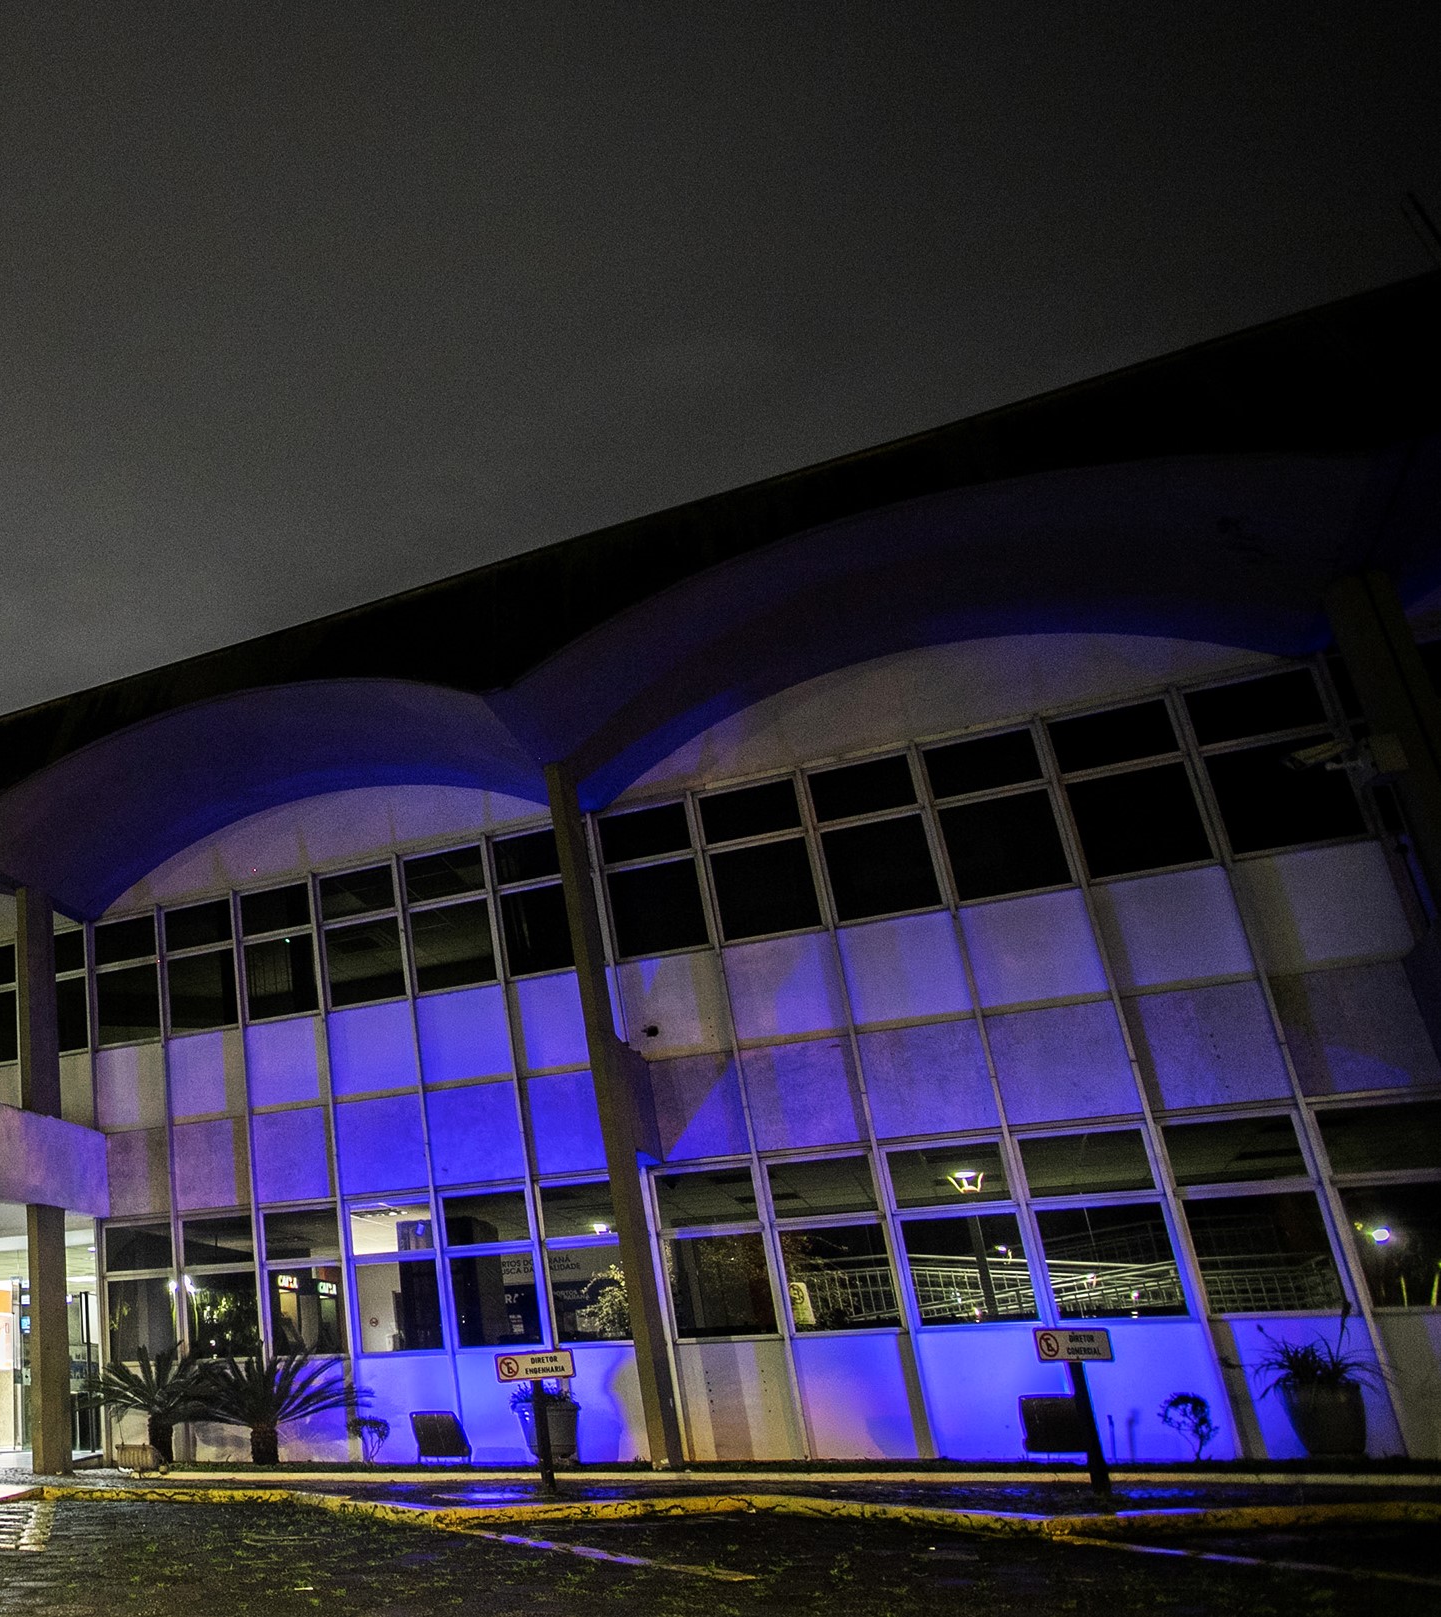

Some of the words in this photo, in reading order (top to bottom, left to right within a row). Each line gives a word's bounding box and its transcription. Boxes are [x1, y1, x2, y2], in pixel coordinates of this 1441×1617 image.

[501, 1260, 522, 1268] RTOS
[502, 1267, 522, 1275] USCA
[530, 1355, 558, 1365] DIRETOR
[525, 1364, 565, 1375] ENGENHARIA
